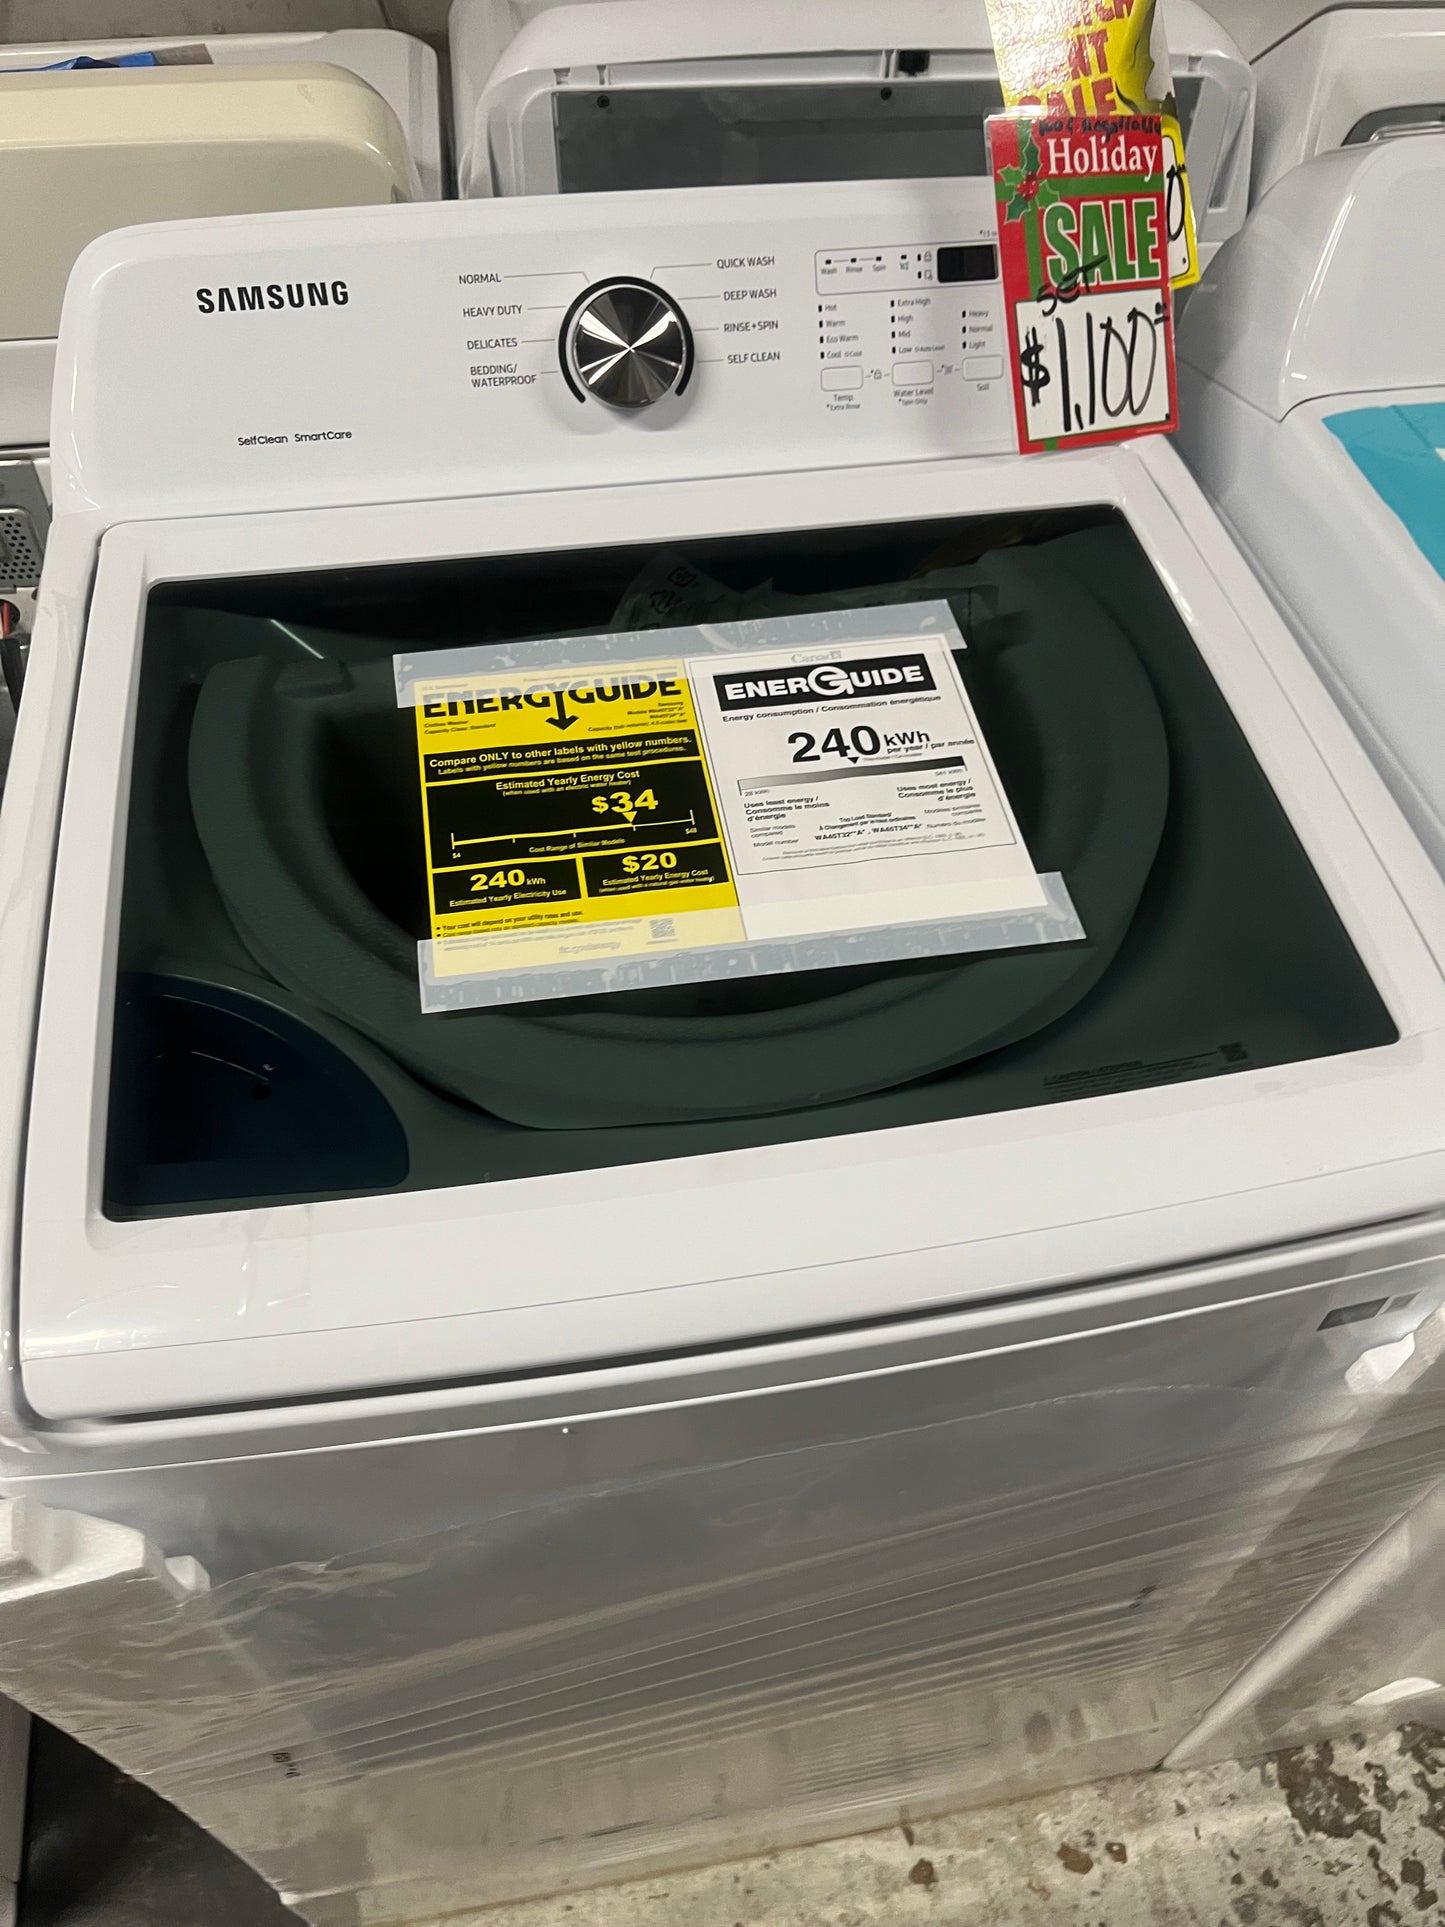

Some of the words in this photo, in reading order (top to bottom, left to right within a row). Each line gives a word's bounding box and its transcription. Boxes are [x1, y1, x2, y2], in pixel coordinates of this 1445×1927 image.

[1046, 134, 1158, 183] Holiday
[1044, 197, 1162, 287] SALE
[716, 257, 746, 269] QUICK
[746, 256, 775, 267] WASH
[458, 273, 502, 285] NORMAL
[196, 280, 349, 314] SAMSUNG
[723, 290, 748, 301] DEEP
[748, 288, 777, 299] WASH
[463, 306, 496, 318] HEAVY
[497, 305, 522, 316] DUTY
[467, 338, 518, 350] DELICATES
[727, 353, 750, 365] SELF
[750, 351, 781, 363] CLEAN
[470, 364, 518, 376] BEDDING/
[472, 375, 537, 388] WATERPROOF
[724, 665, 925, 701] ENERGUIDE
[722, 713, 754, 724] Energy
[756, 707, 814, 719] consumption
[821, 698, 888, 712] Consommation
[429, 755, 477, 768] Compare
[479, 751, 509, 762] ONLY
[511, 752, 522, 760] to
[524, 749, 552, 759] other
[554, 745, 584, 756] labels
[586, 744, 608, 753] with
[609, 741, 643, 753] yellow
[645, 736, 693, 747] numbers.
[787, 725, 881, 763] 240
[884, 730, 931, 747] kWh
[495, 778, 545, 790] Estimated
[547, 775, 578, 787] Yearly
[580, 773, 614, 783] Energy
[617, 770, 640, 780] Cost
[591, 788, 659, 814] $34
[621, 852, 677, 874] $20
[470, 869, 526, 892] 240
[526, 877, 546, 886] kWh
[602, 875, 639, 887] Estimated
[640, 873, 663, 882] Yearly
[664, 871, 690, 879] Energy
[691, 869, 709, 877] Cost
[449, 896, 487, 907] Estimated
[488, 893, 512, 903] Yearly
[513, 889, 550, 900] Electricity
